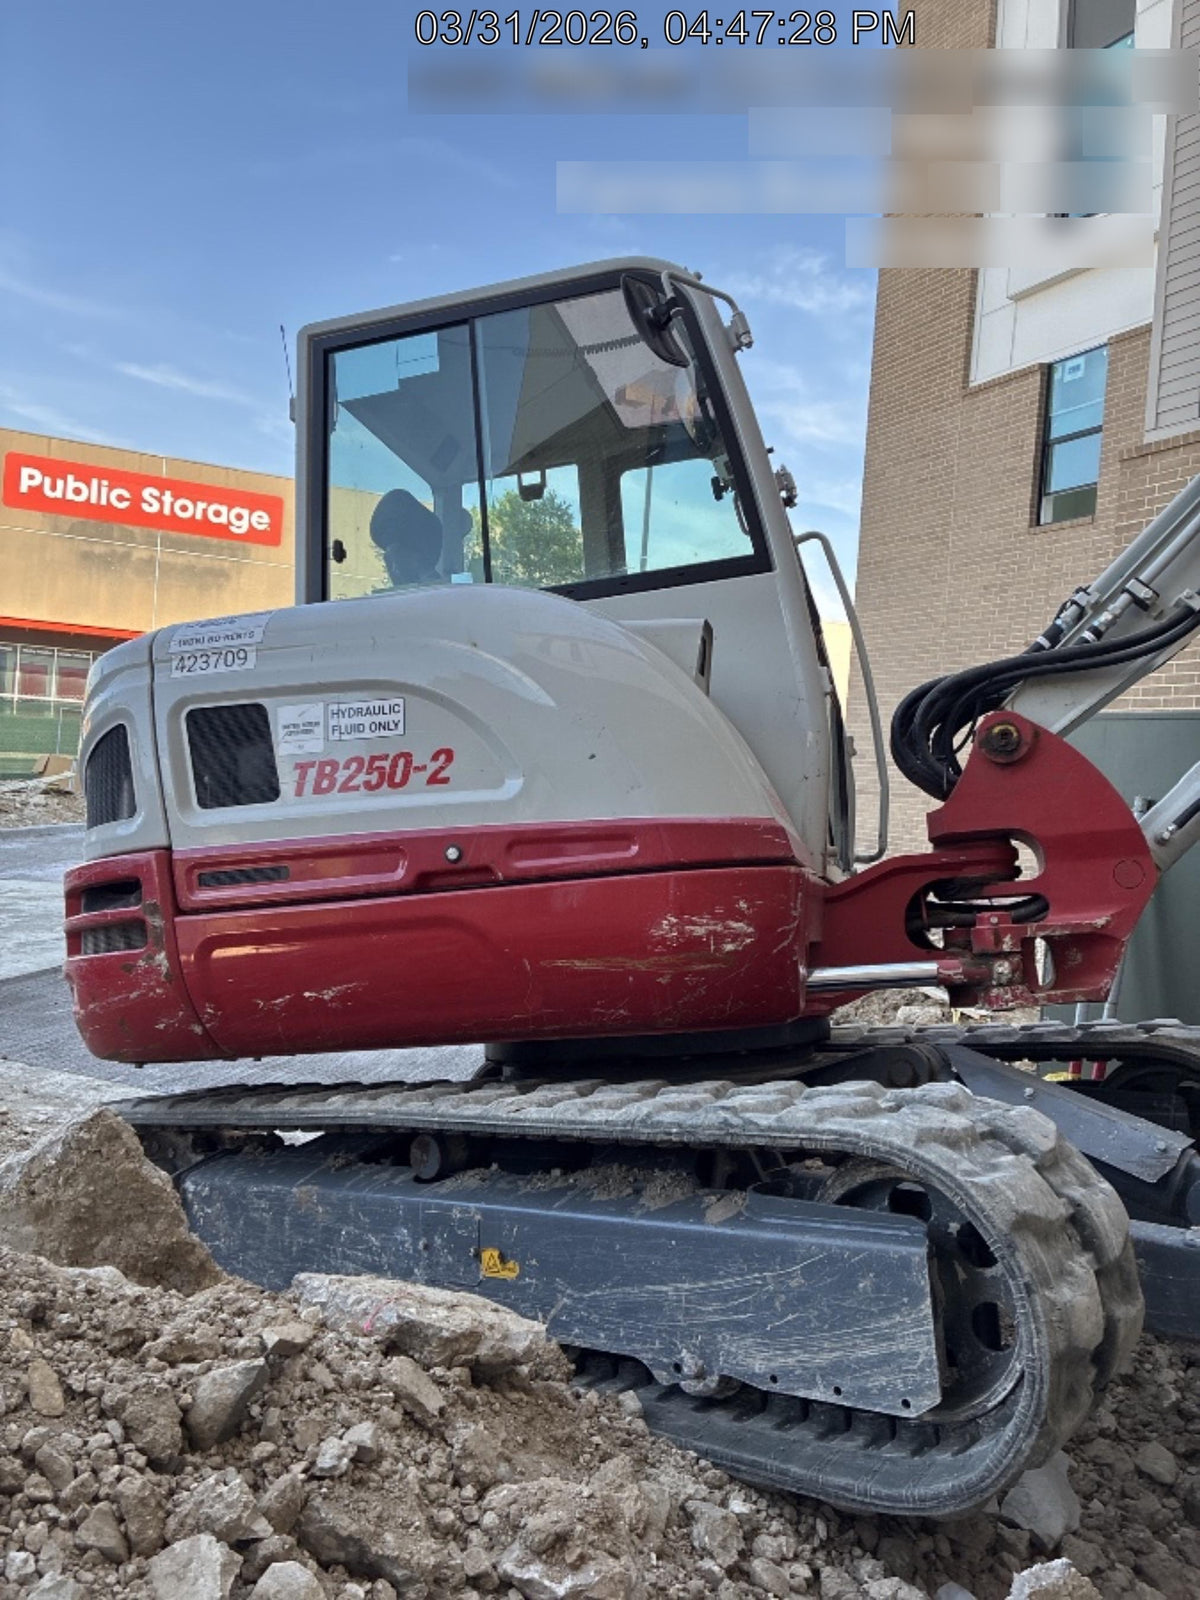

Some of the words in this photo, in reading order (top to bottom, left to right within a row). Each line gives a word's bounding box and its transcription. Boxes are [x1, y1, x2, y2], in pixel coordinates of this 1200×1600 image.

[19, 466, 131, 509] Public
[141, 486, 271, 534] Storage
[174, 648, 249, 673] 423709
[331, 703, 401, 719] HYDRAULIC
[331, 723, 366, 736] FLUID
[368, 720, 401, 733] ONLY
[293, 747, 455, 797] TB250-2
